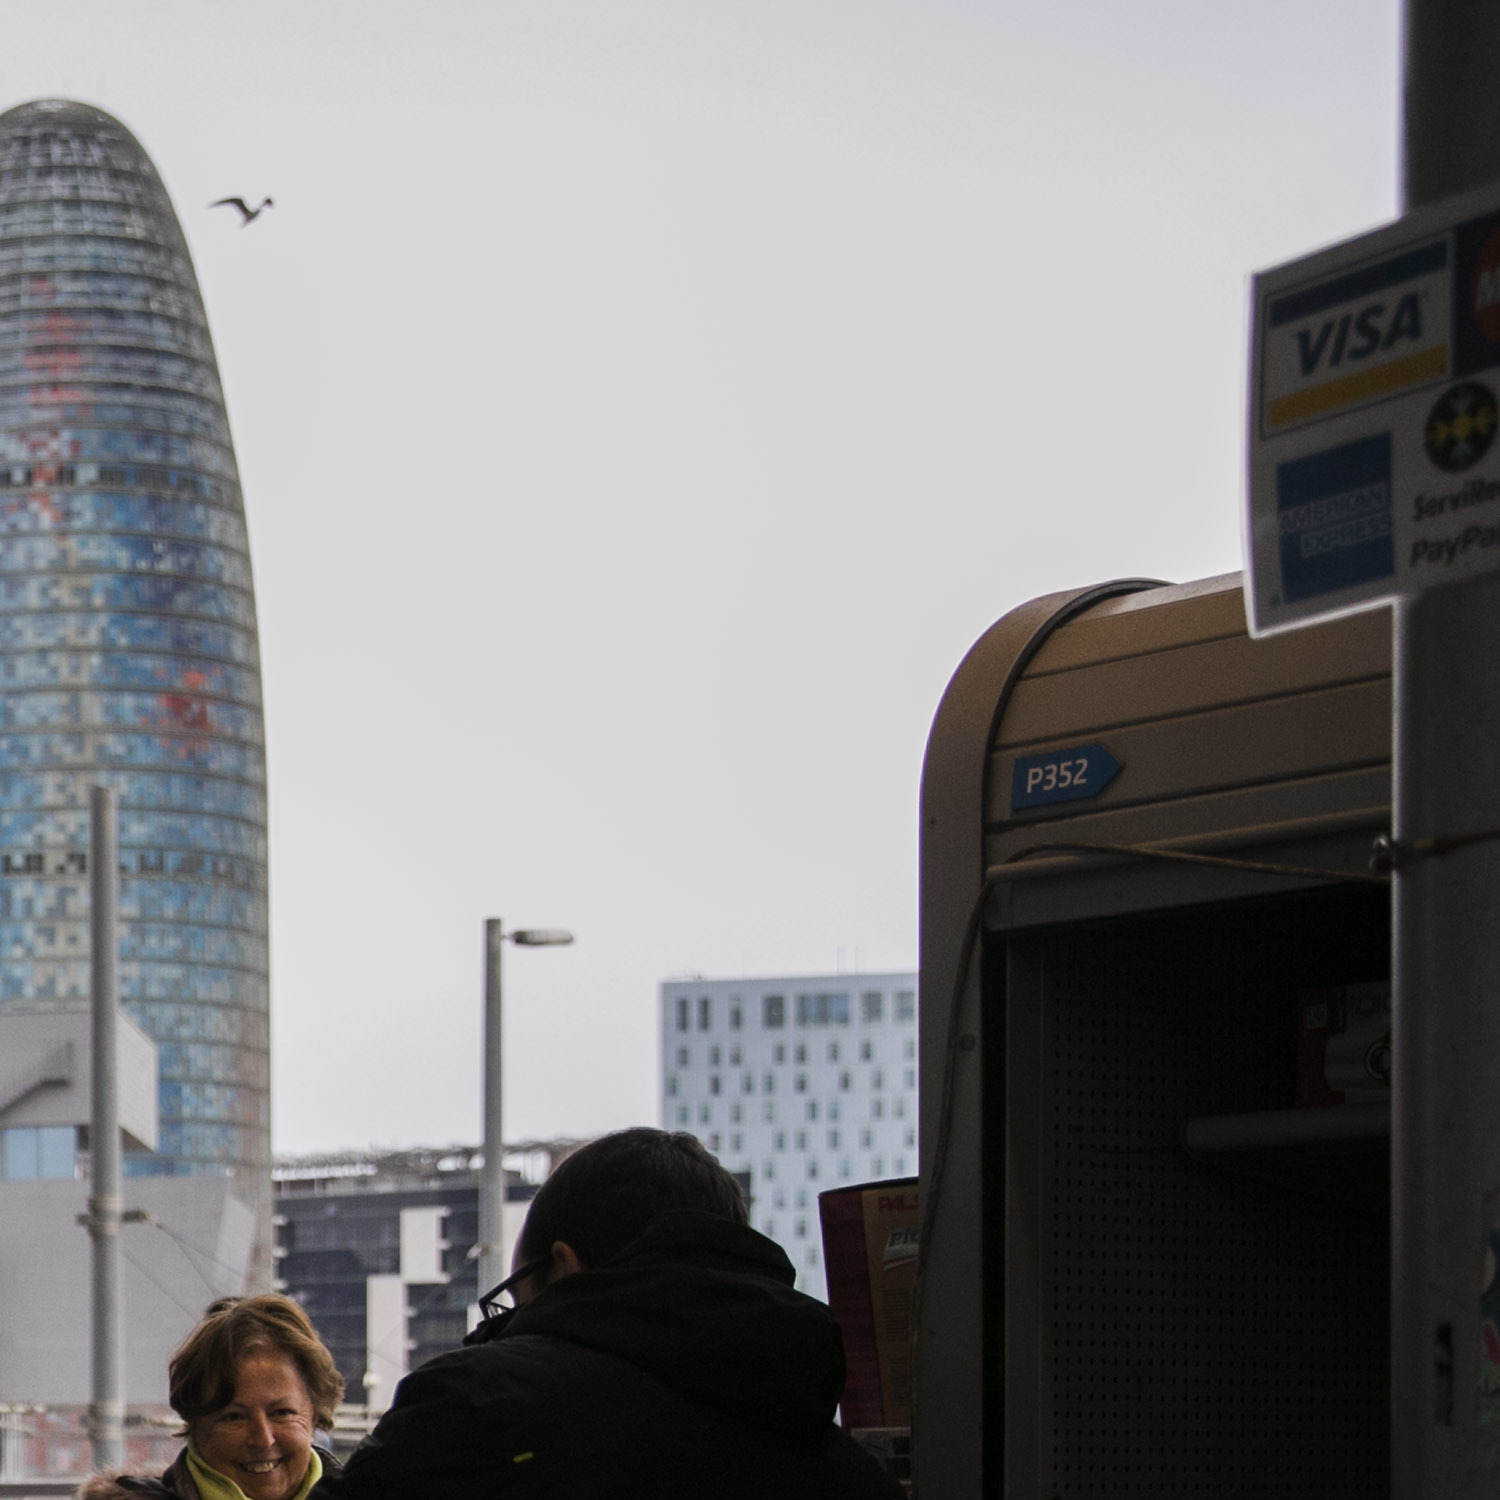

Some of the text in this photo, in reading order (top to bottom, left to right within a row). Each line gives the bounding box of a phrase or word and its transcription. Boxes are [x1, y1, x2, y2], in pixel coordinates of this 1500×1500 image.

[1297, 291, 1421, 376] VISA
[1280, 482, 1387, 533] AMERICAN
[1413, 480, 1500, 521] ServiRe
[1301, 511, 1393, 559] EXPRESS
[1026, 758, 1088, 794] P352
